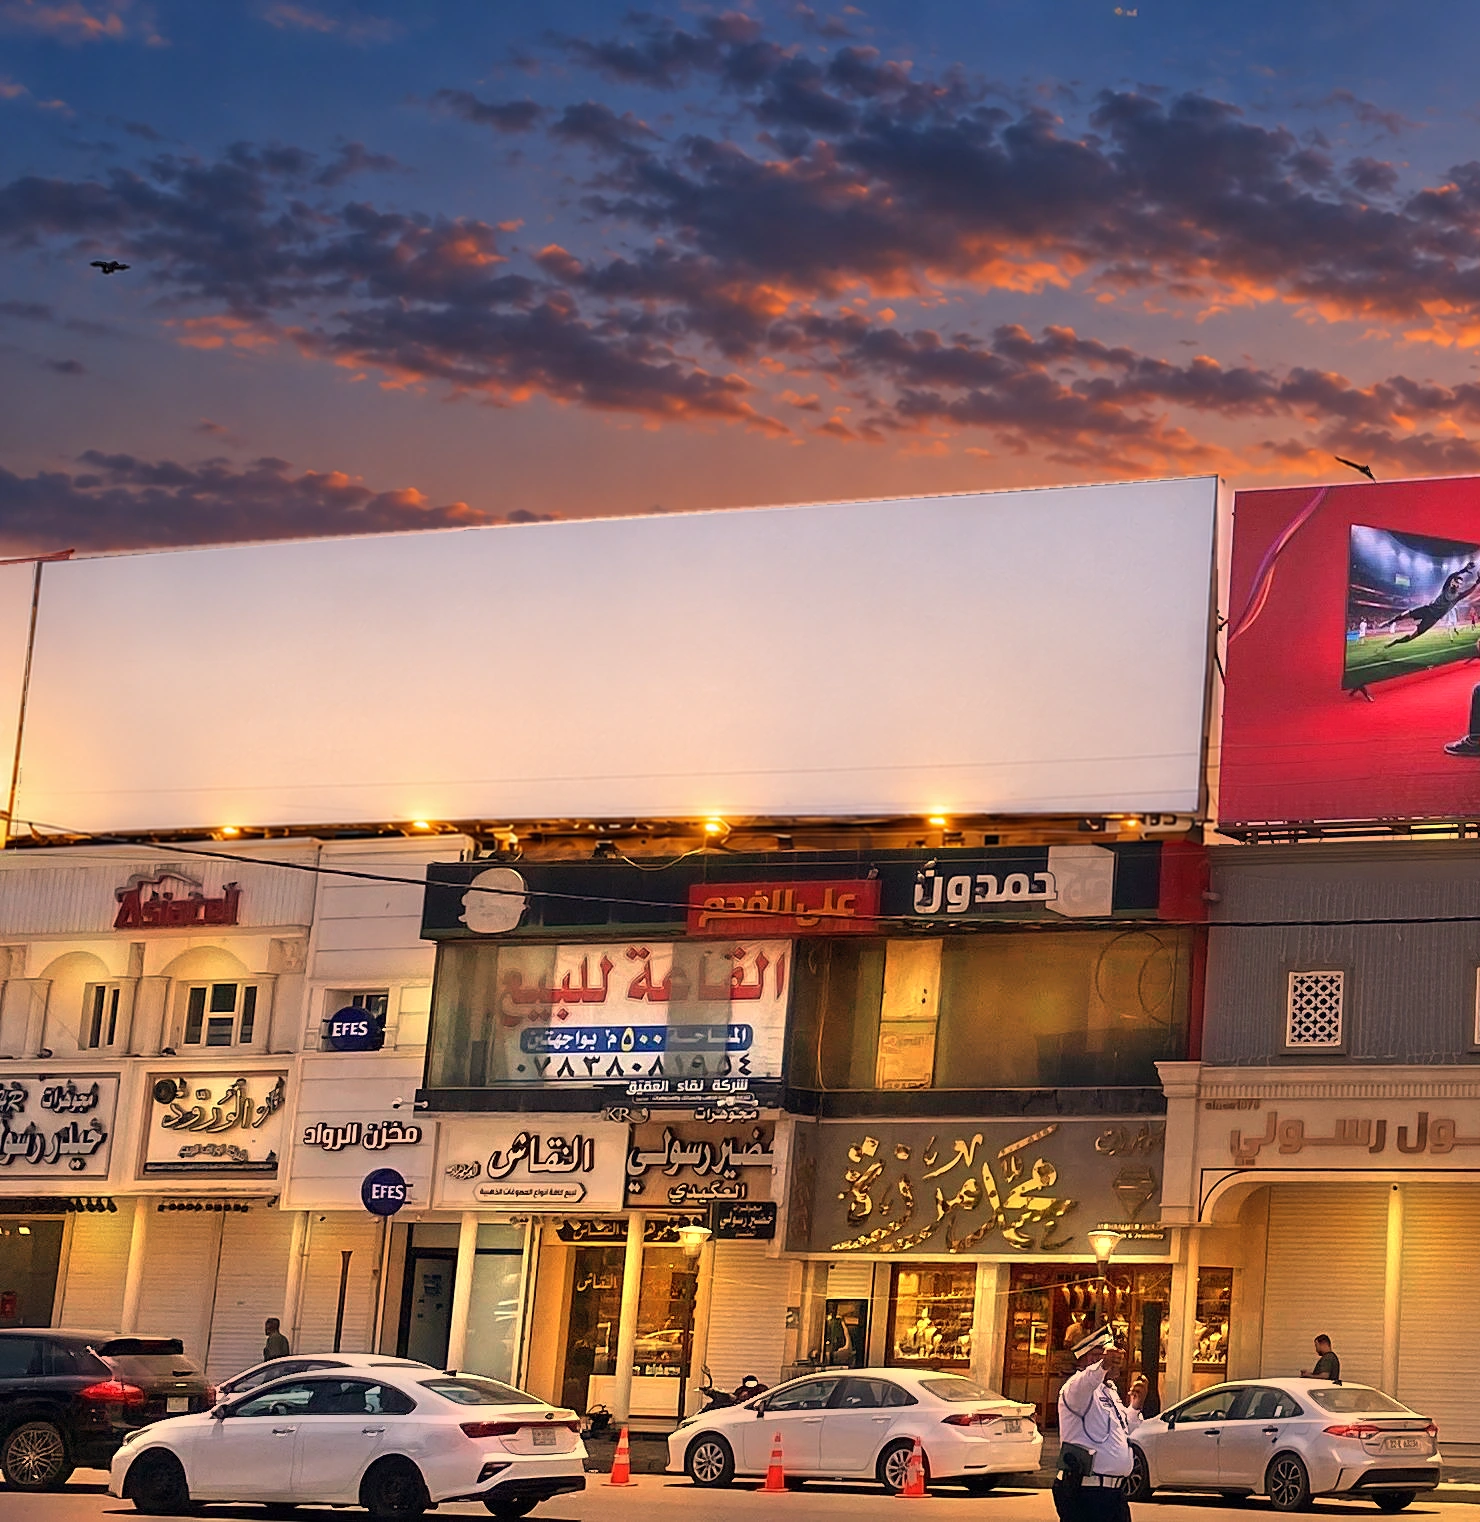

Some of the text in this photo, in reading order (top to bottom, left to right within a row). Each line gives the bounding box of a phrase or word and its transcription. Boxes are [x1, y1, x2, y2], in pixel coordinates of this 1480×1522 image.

[914, 868, 1059, 915] حمدون
[502, 944, 787, 1028] القاعة للبيع
[332, 1021, 368, 1037] EFES
[625, 1079, 749, 1096] شركة لقاء العقيق
[694, 1106, 758, 1124] مجوهرات
[303, 1120, 422, 1152] مخزن الرواد
[487, 1131, 595, 1179] النقاش
[1229, 1111, 1388, 1166] رسولي
[626, 1126, 711, 1194] رسولي
[371, 1183, 405, 1200] EFES
